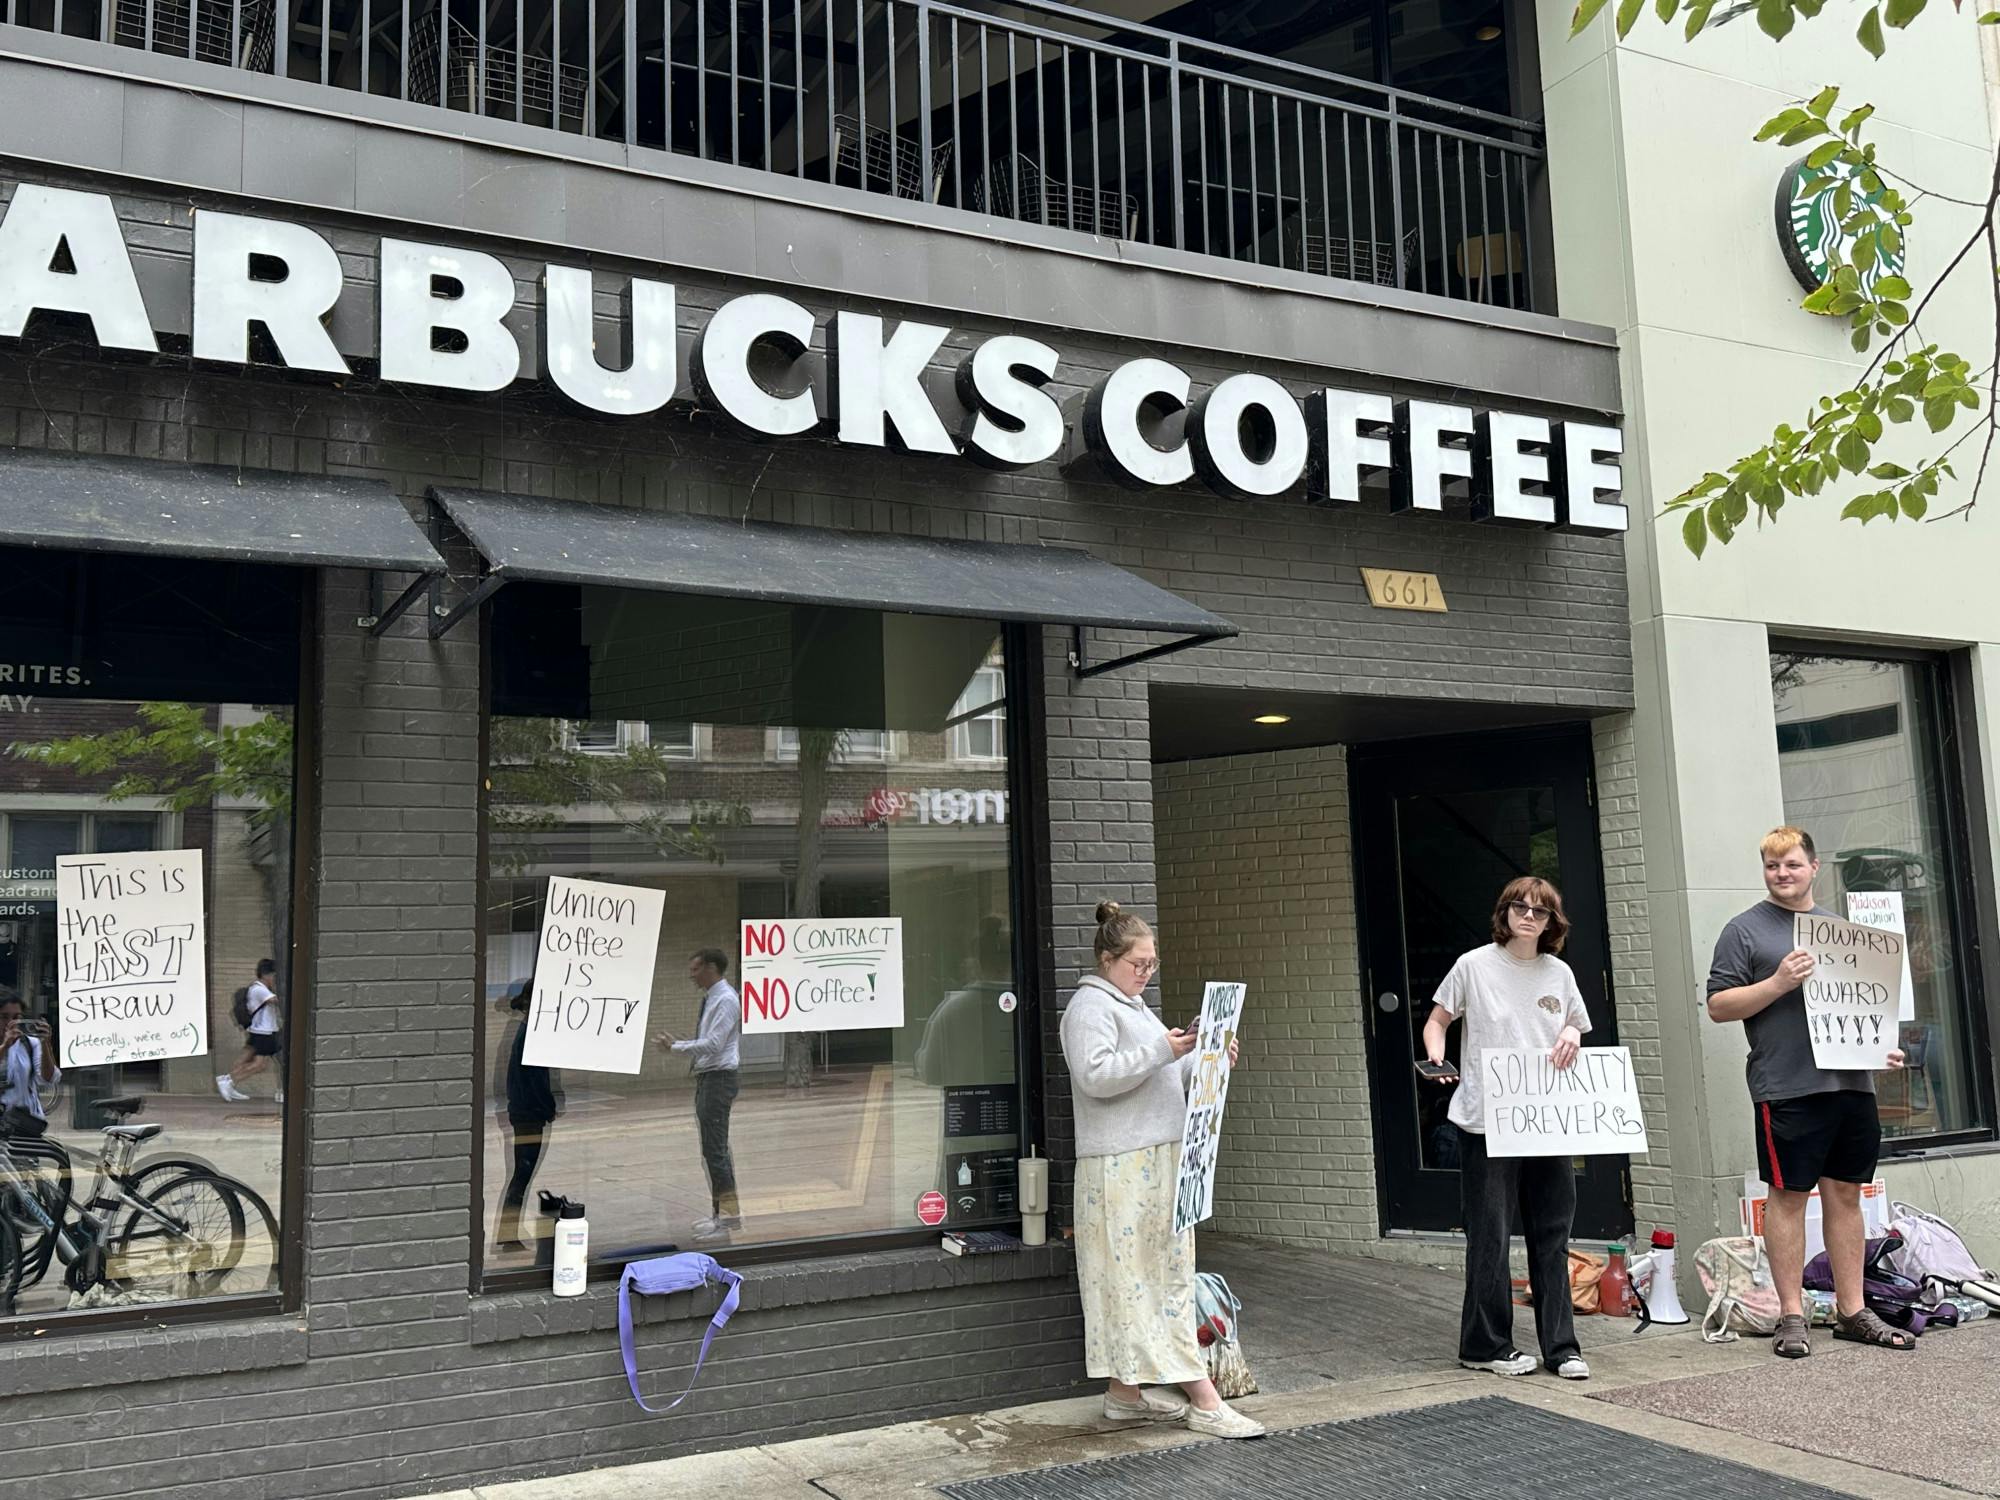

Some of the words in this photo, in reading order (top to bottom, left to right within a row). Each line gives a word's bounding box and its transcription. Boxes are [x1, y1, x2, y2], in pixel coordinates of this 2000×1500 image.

[0, 183, 1065, 465] ARBUCKS
[1092, 357, 1629, 532] COFFEE
[1383, 574, 1428, 606] 661
[0, 867, 56, 878] ustom
[61, 863, 146, 900] This
[160, 864, 185, 893] is
[550, 883, 635, 926] Union
[1848, 894, 1892, 911] Madison
[60, 907, 119, 940] the
[745, 924, 786, 957] NO
[793, 923, 894, 953] CONTRACT
[1797, 916, 1900, 955] HOWARD
[64, 923, 194, 983] LAST
[1818, 953, 1835, 966] is
[564, 958, 594, 987] is
[534, 989, 639, 1036] HOT!
[743, 977, 790, 1024] NO
[1490, 1052, 1628, 1098] SOLIDARITY
[1495, 1101, 1618, 1137] FOREVER
